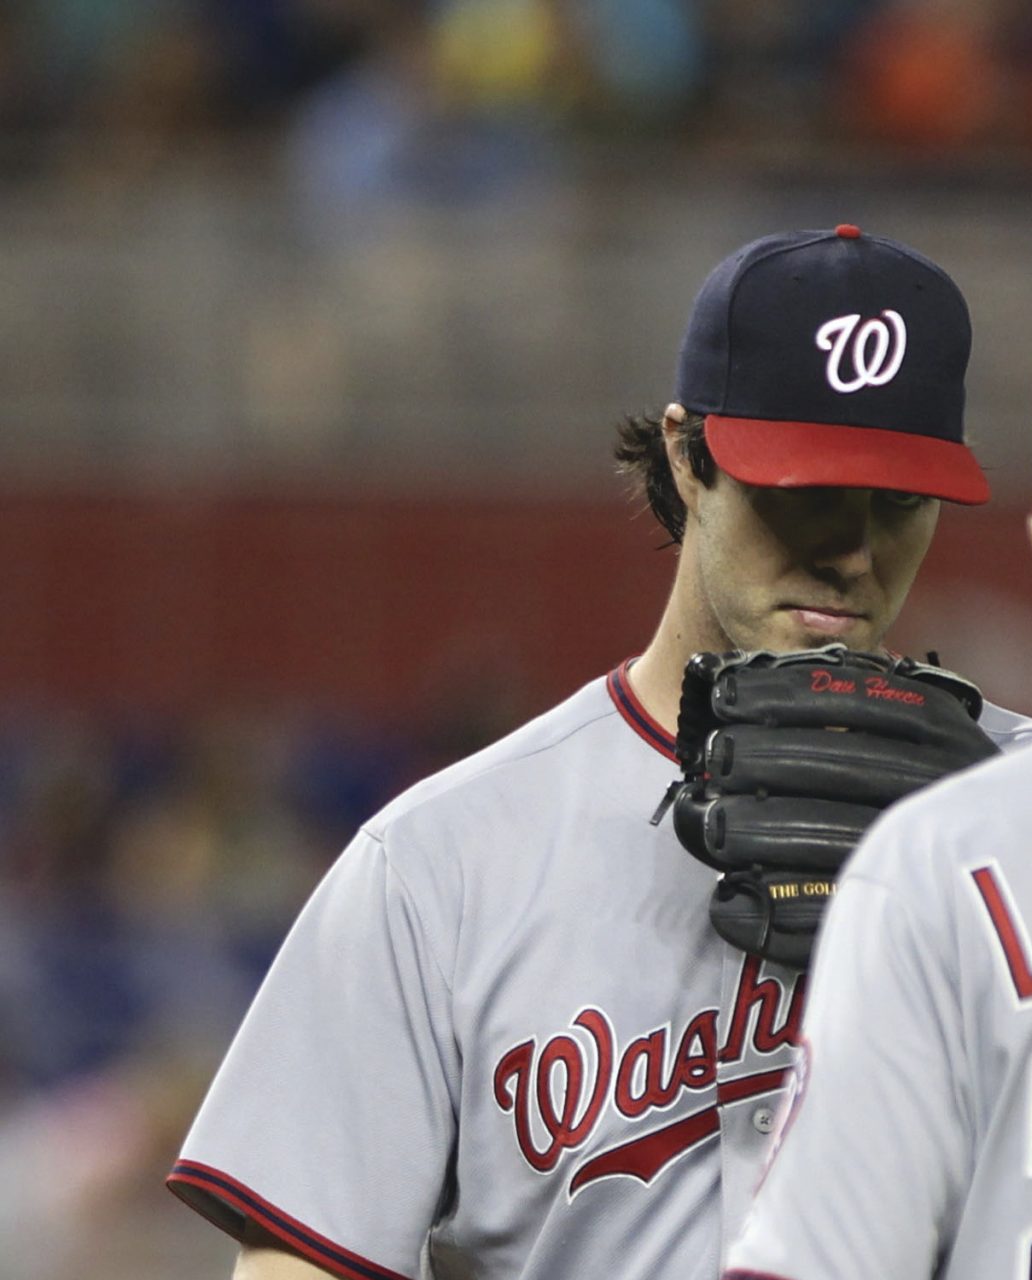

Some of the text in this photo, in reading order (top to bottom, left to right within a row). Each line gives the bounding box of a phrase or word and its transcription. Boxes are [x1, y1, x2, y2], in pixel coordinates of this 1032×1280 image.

[815, 308, 908, 394] W
[810, 667, 856, 693] Dan
[768, 882, 800, 900] THE
